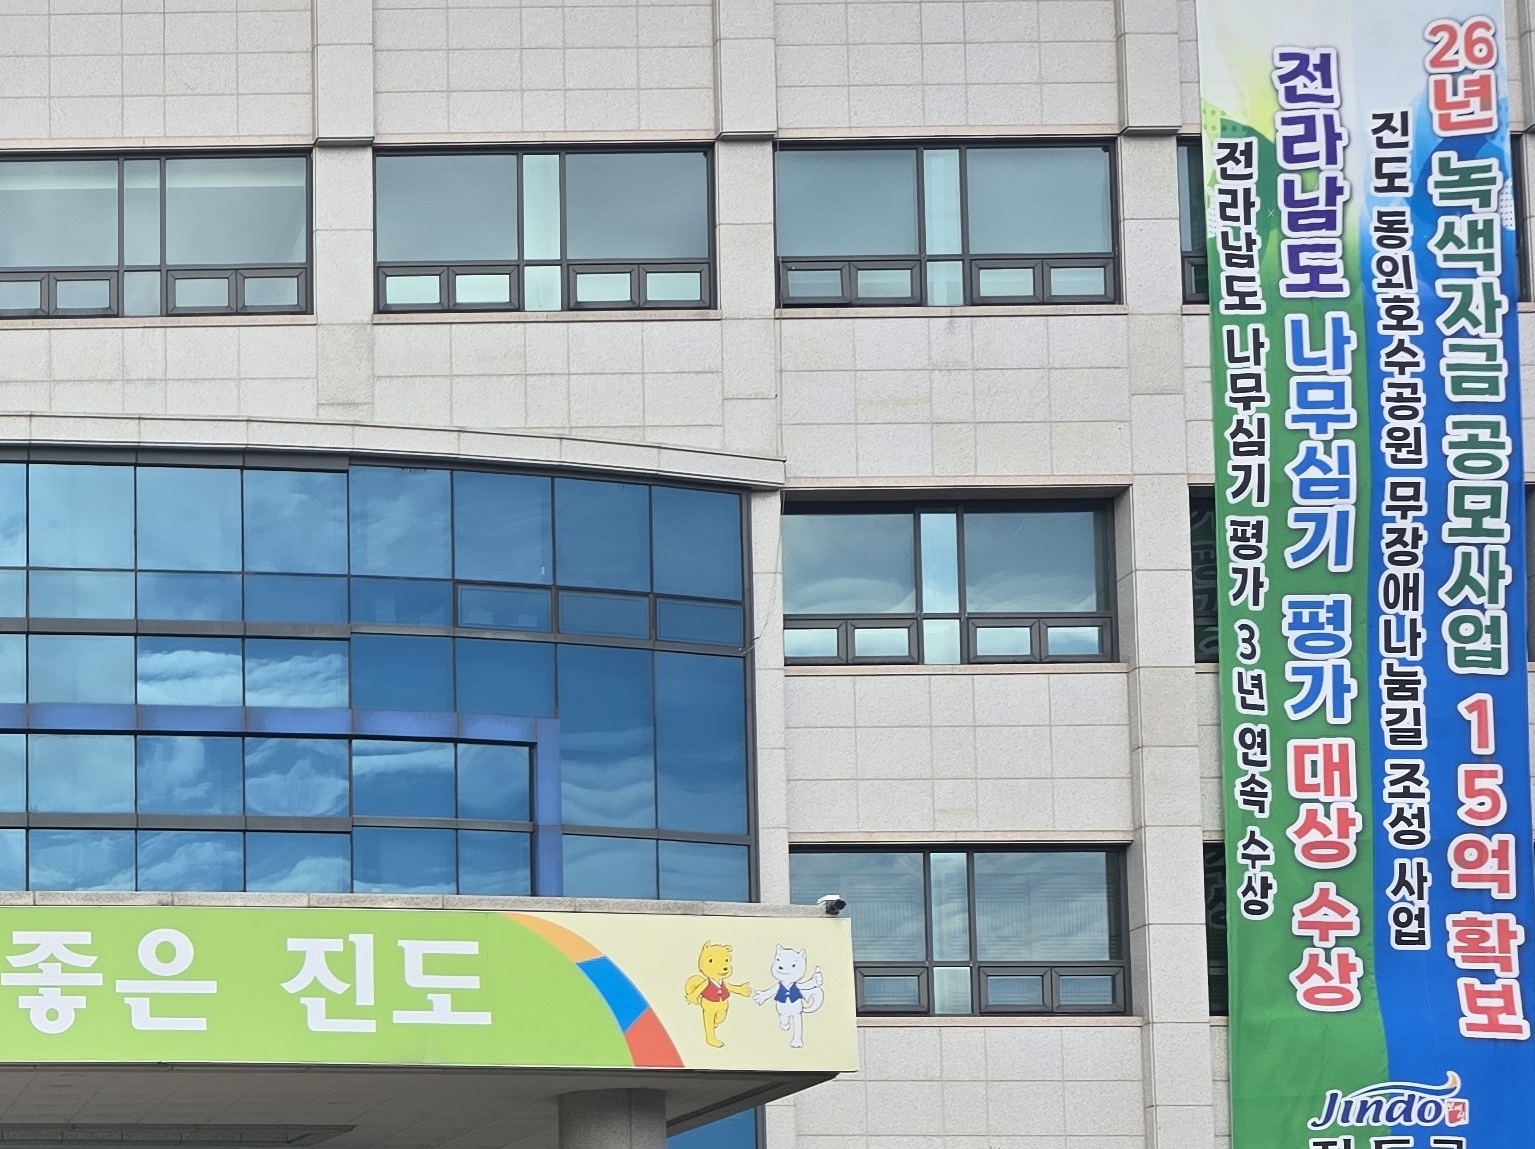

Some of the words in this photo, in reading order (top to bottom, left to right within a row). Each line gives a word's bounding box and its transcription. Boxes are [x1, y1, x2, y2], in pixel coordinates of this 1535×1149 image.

[1426, 19, 1496, 135] 26년
[1272, 47, 1350, 298] 전라남도
[1371, 109, 1413, 196] 진도
[1214, 138, 1268, 316] 전라남도
[1431, 155, 1507, 402] 녹색자금
[1371, 208, 1424, 466] 동외호수공원
[1223, 325, 1270, 507] 나무심기
[1284, 312, 1356, 571] 나무심기
[1226, 516, 1268, 610] 평가
[1443, 416, 1510, 672] 공모사업
[1283, 595, 1356, 724] 평가
[1379, 477, 1427, 746] 무장애나눔길
[1285, 737, 1357, 869] 대상
[1383, 760, 1430, 848] 조성
[1447, 695, 1517, 899] 15억
[1237, 827, 1275, 919] 수상
[1388, 858, 1431, 949] 사업
[280, 931, 493, 1033] 진도
[1290, 882, 1362, 1012] 수상
[1448, 914, 1530, 1040] 확보
[1310, 1092, 1443, 1128] Jindo
